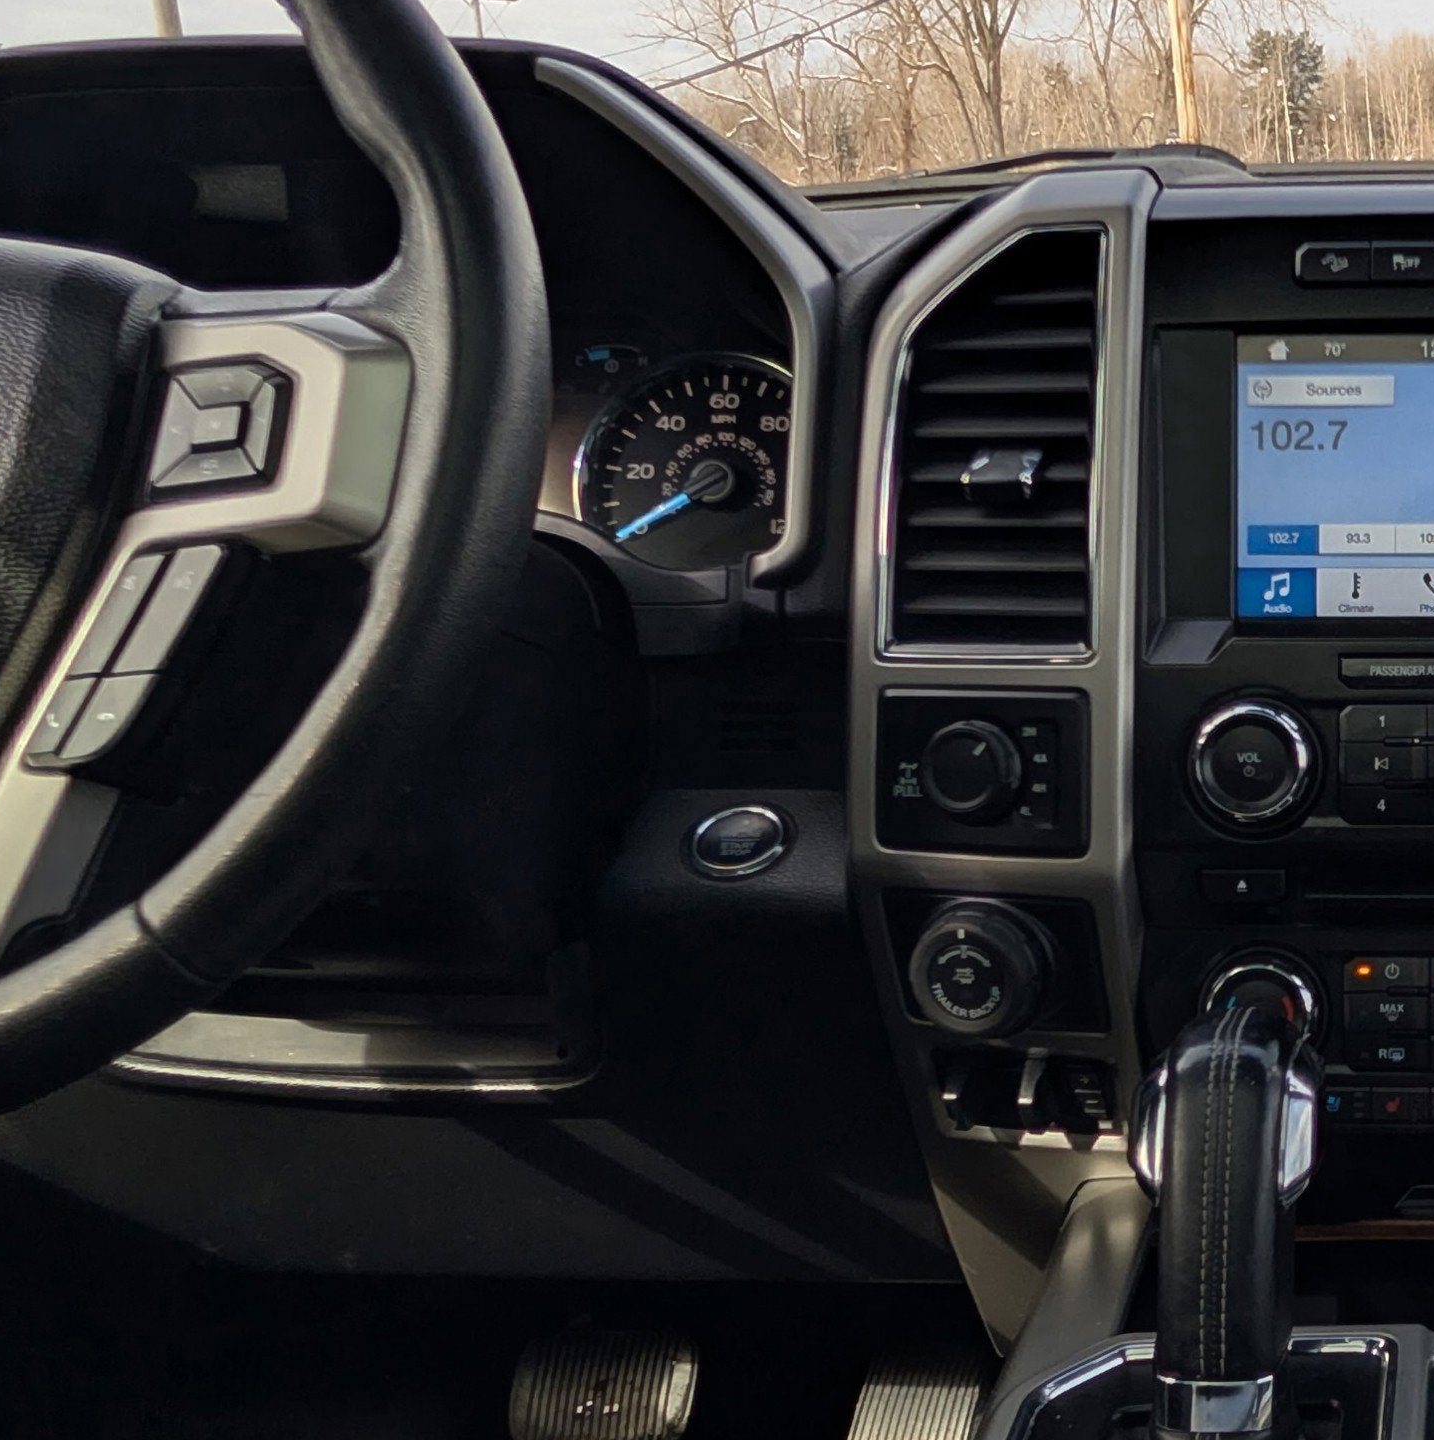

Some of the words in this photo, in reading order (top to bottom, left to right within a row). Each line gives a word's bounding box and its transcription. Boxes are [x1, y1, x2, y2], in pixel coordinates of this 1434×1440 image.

[1305, 381, 1363, 398] Sources
[709, 393, 740, 409] 60
[655, 415, 686, 432] 40
[760, 416, 791, 432] 80
[1250, 420, 1349, 451] 102.7
[626, 463, 655, 479] 20
[1268, 532, 1300, 545] 102.7
[1337, 602, 1374, 614] Climate
[1378, 714, 1386, 727] 1
[1236, 752, 1262, 764] VOL
[1376, 799, 1387, 812] 4
[1379, 1003, 1405, 1013] MAX
